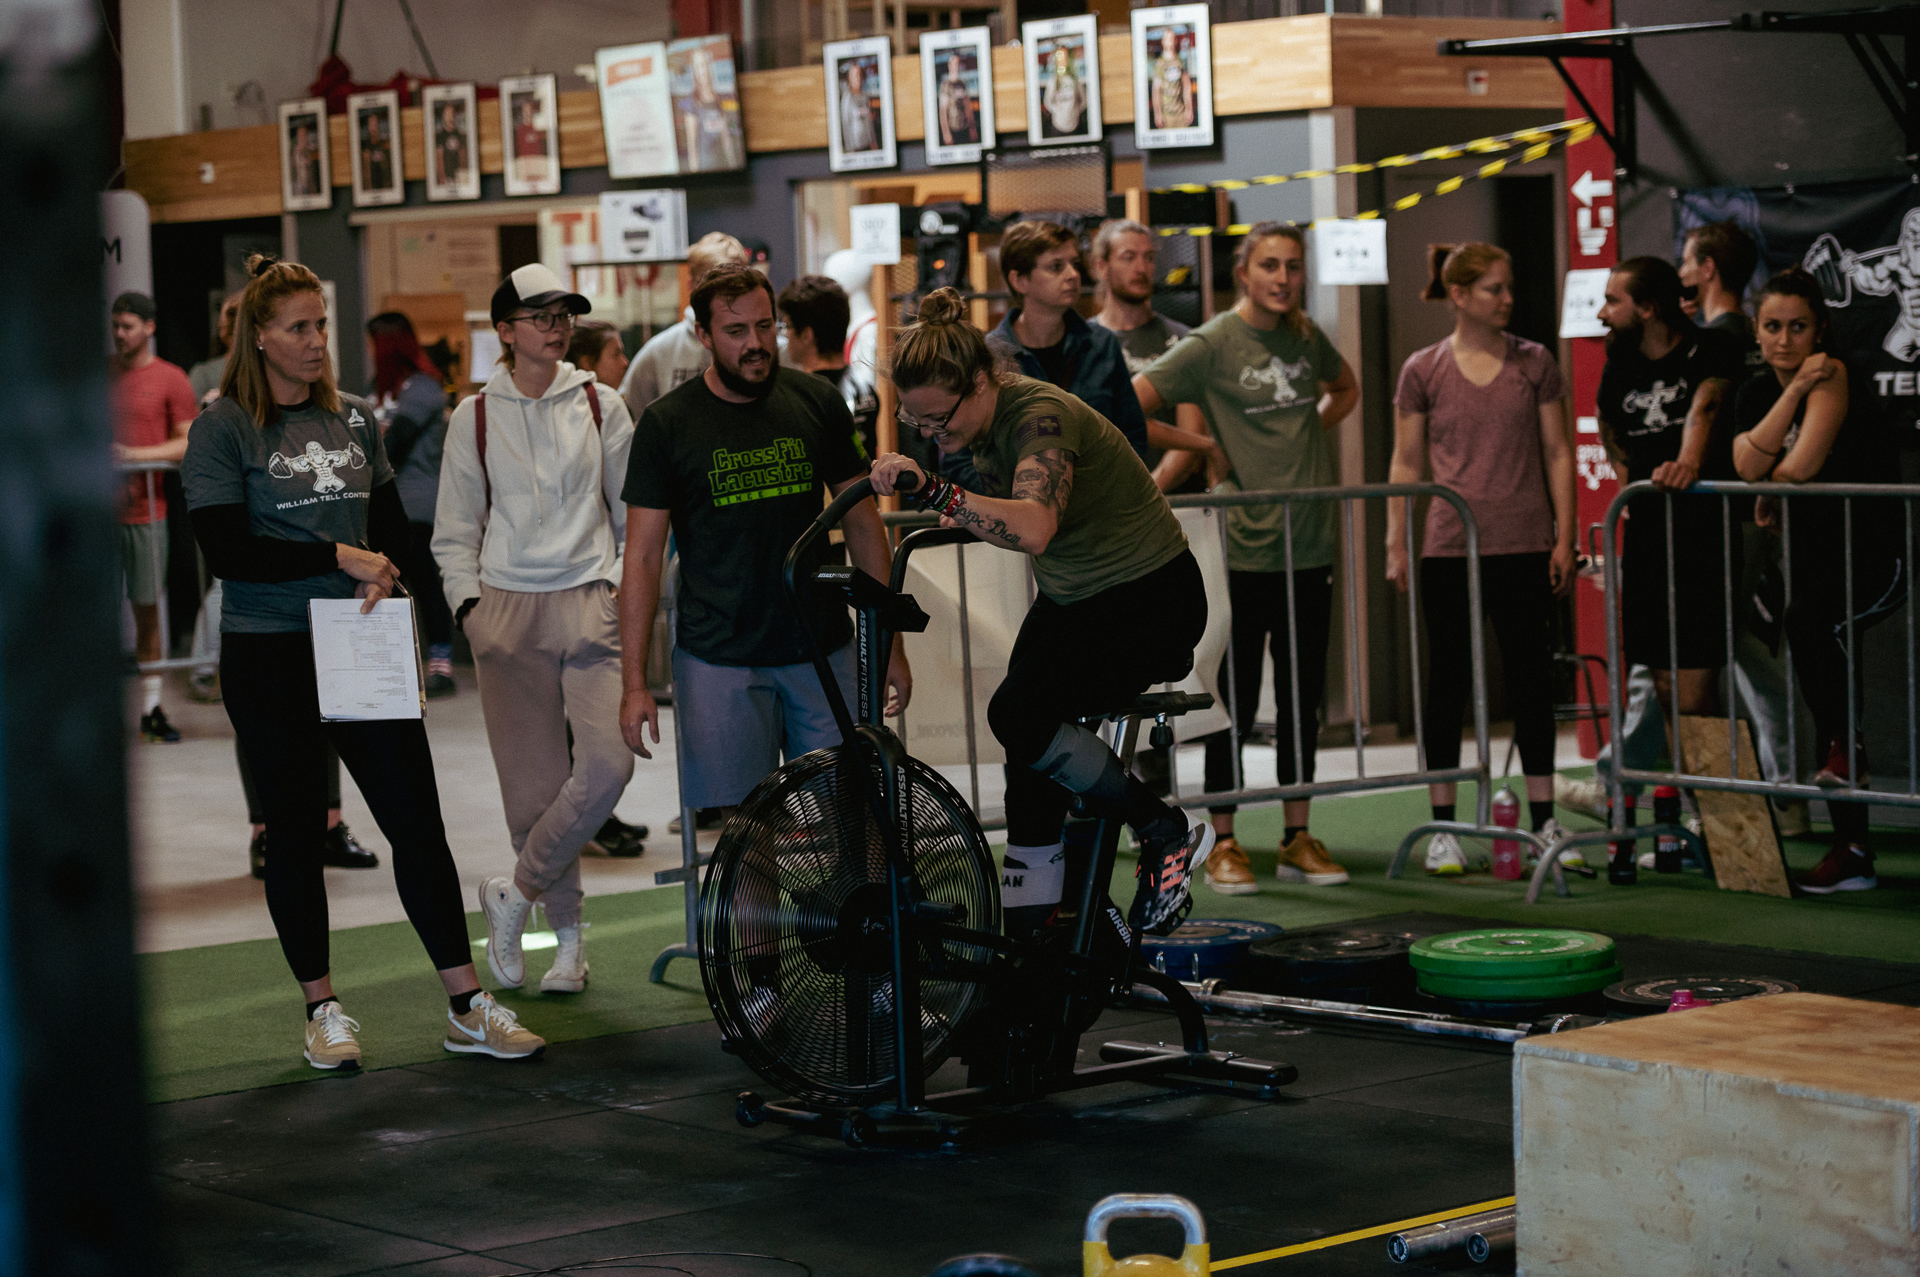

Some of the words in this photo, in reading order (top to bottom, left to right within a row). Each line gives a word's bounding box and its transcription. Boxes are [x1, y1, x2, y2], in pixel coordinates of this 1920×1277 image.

[1873, 371, 1920, 397] TE
[712, 437, 807, 473] CrossFit
[707, 460, 814, 497] Lacustre
[276, 496, 318, 510] WILLIAM
[320, 494, 341, 502] TELL
[716, 490, 764, 506] SINCE
[956, 504, 986, 529] arpe
[859, 608, 869, 718] ASSAULTFITNESS
[896, 764, 910, 863] ASSAULTFITNE
[1001, 875, 1024, 888] AN
[1106, 907, 1133, 948] AIRBIK
